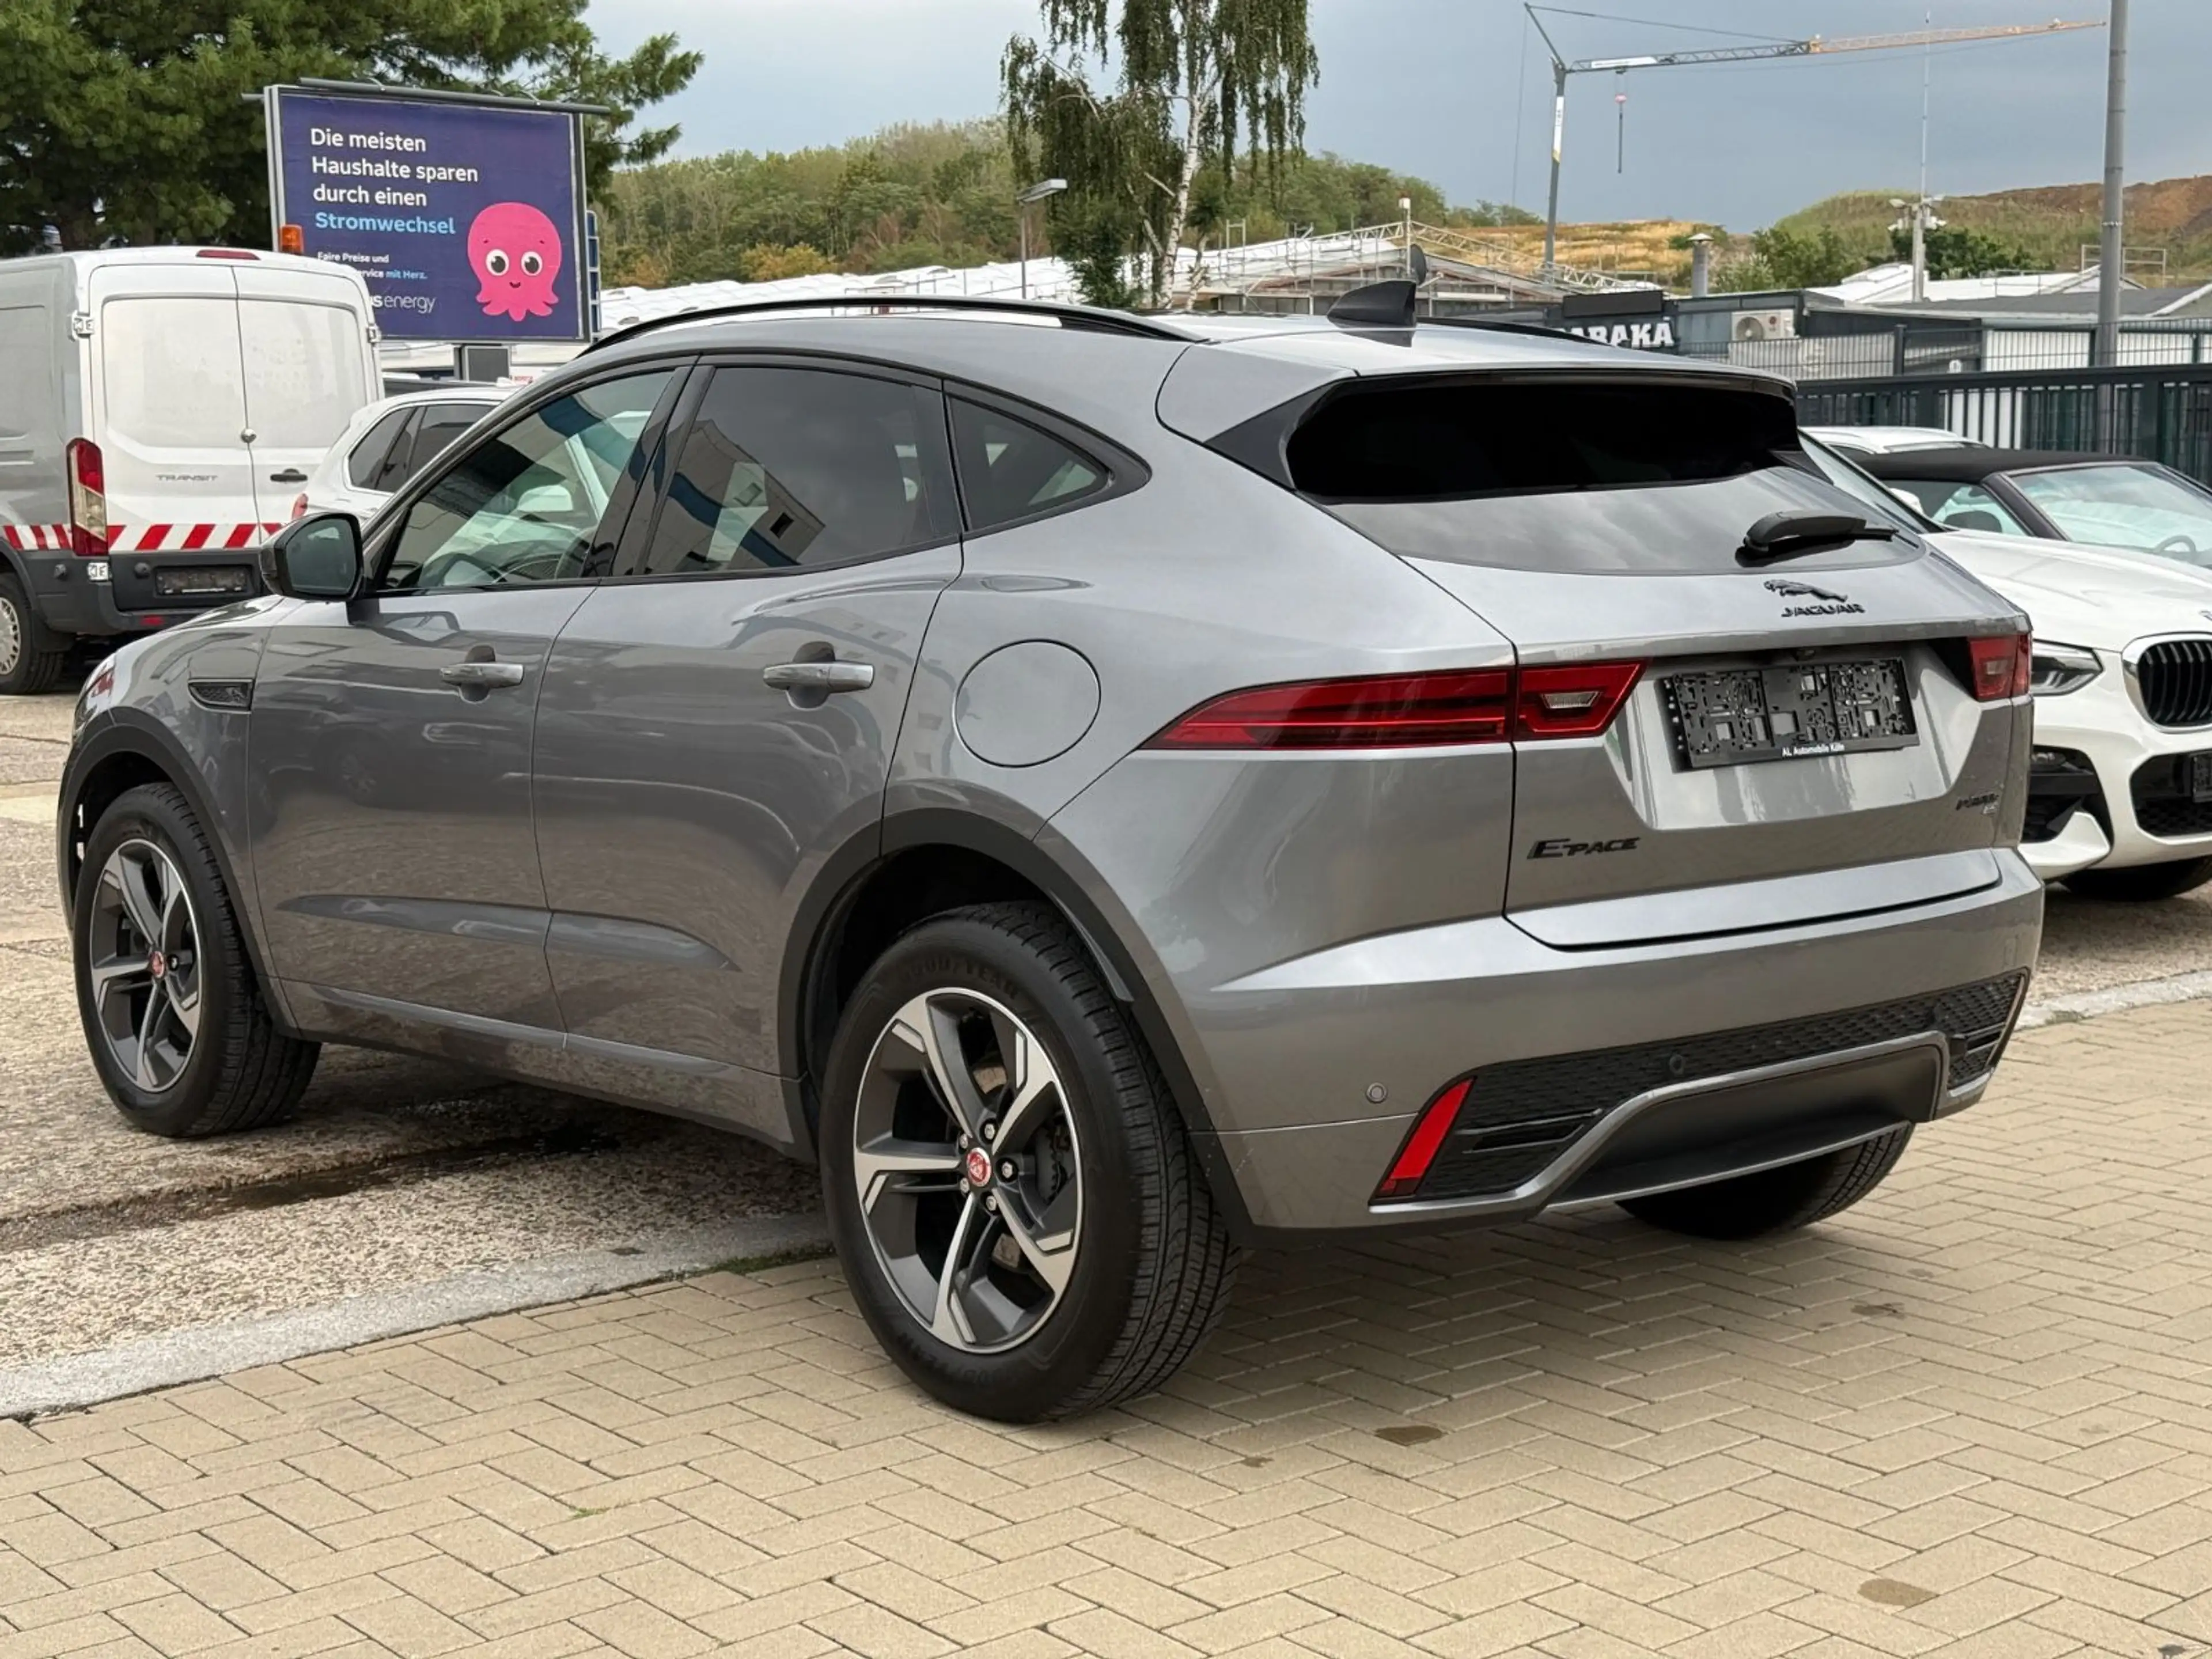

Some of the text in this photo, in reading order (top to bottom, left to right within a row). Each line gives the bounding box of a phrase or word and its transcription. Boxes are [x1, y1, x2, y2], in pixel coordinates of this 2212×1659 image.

[310, 128, 426, 152] Die meisten
[312, 156, 478, 183] Haushalte sparen
[313, 183, 427, 207] durch einen
[315, 211, 456, 234] Stromwechsel
[342, 252, 370, 263] Preise
[372, 254, 389, 263] und
[358, 268, 384, 278] rvice
[385, 269, 402, 279] mit
[1555, 318, 1675, 350] RAKA
[155, 474, 218, 482] TRANSIT
[1781, 603, 1866, 618] JAGUAR
